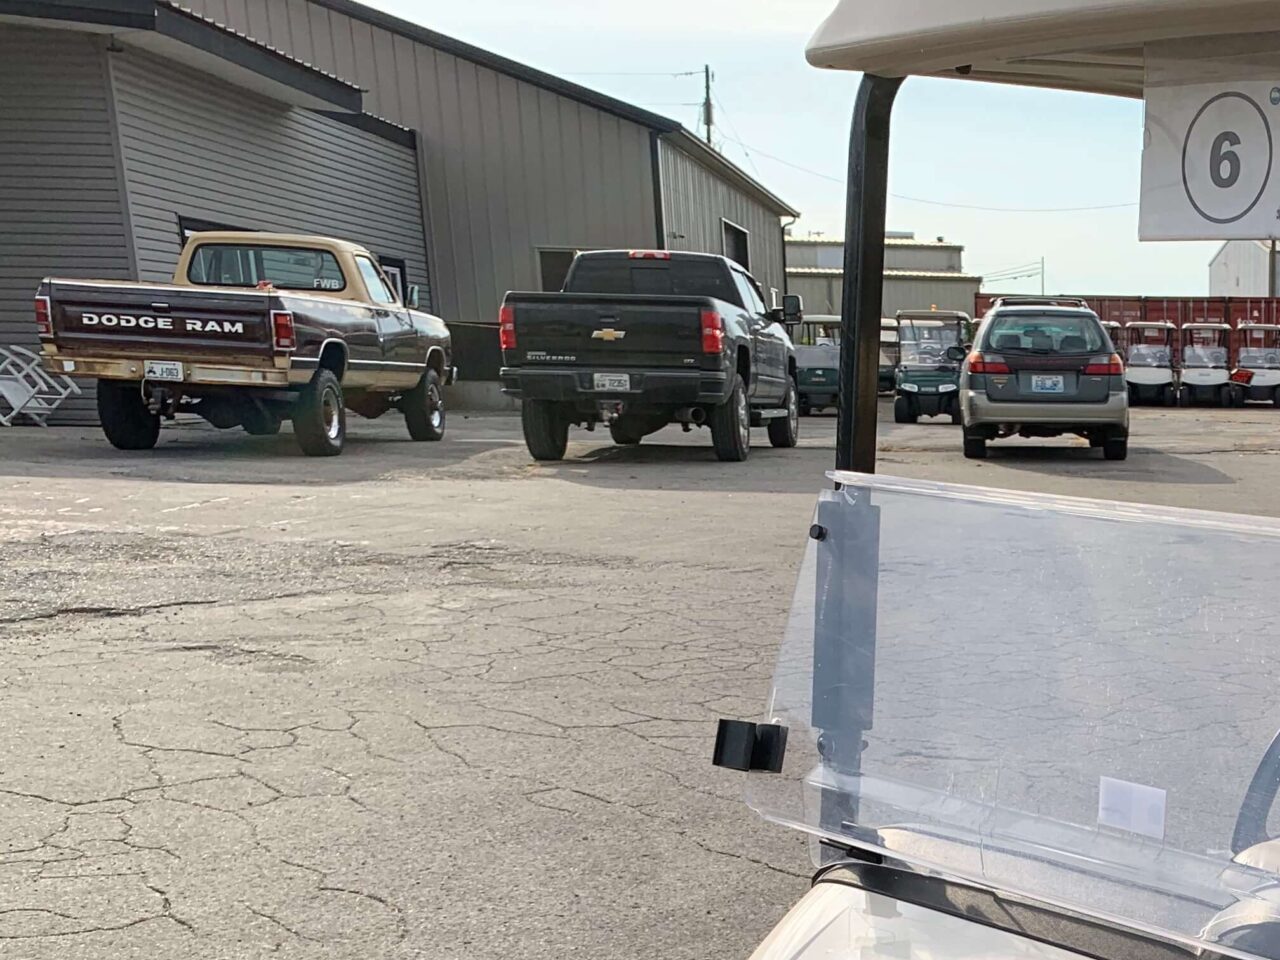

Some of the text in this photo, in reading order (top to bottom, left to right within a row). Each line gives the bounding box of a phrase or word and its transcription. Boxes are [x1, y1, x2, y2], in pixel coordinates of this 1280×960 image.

[1209, 131, 1241, 189] 6
[313, 278, 340, 289] FWB
[81, 313, 244, 333] DODGE RAM
